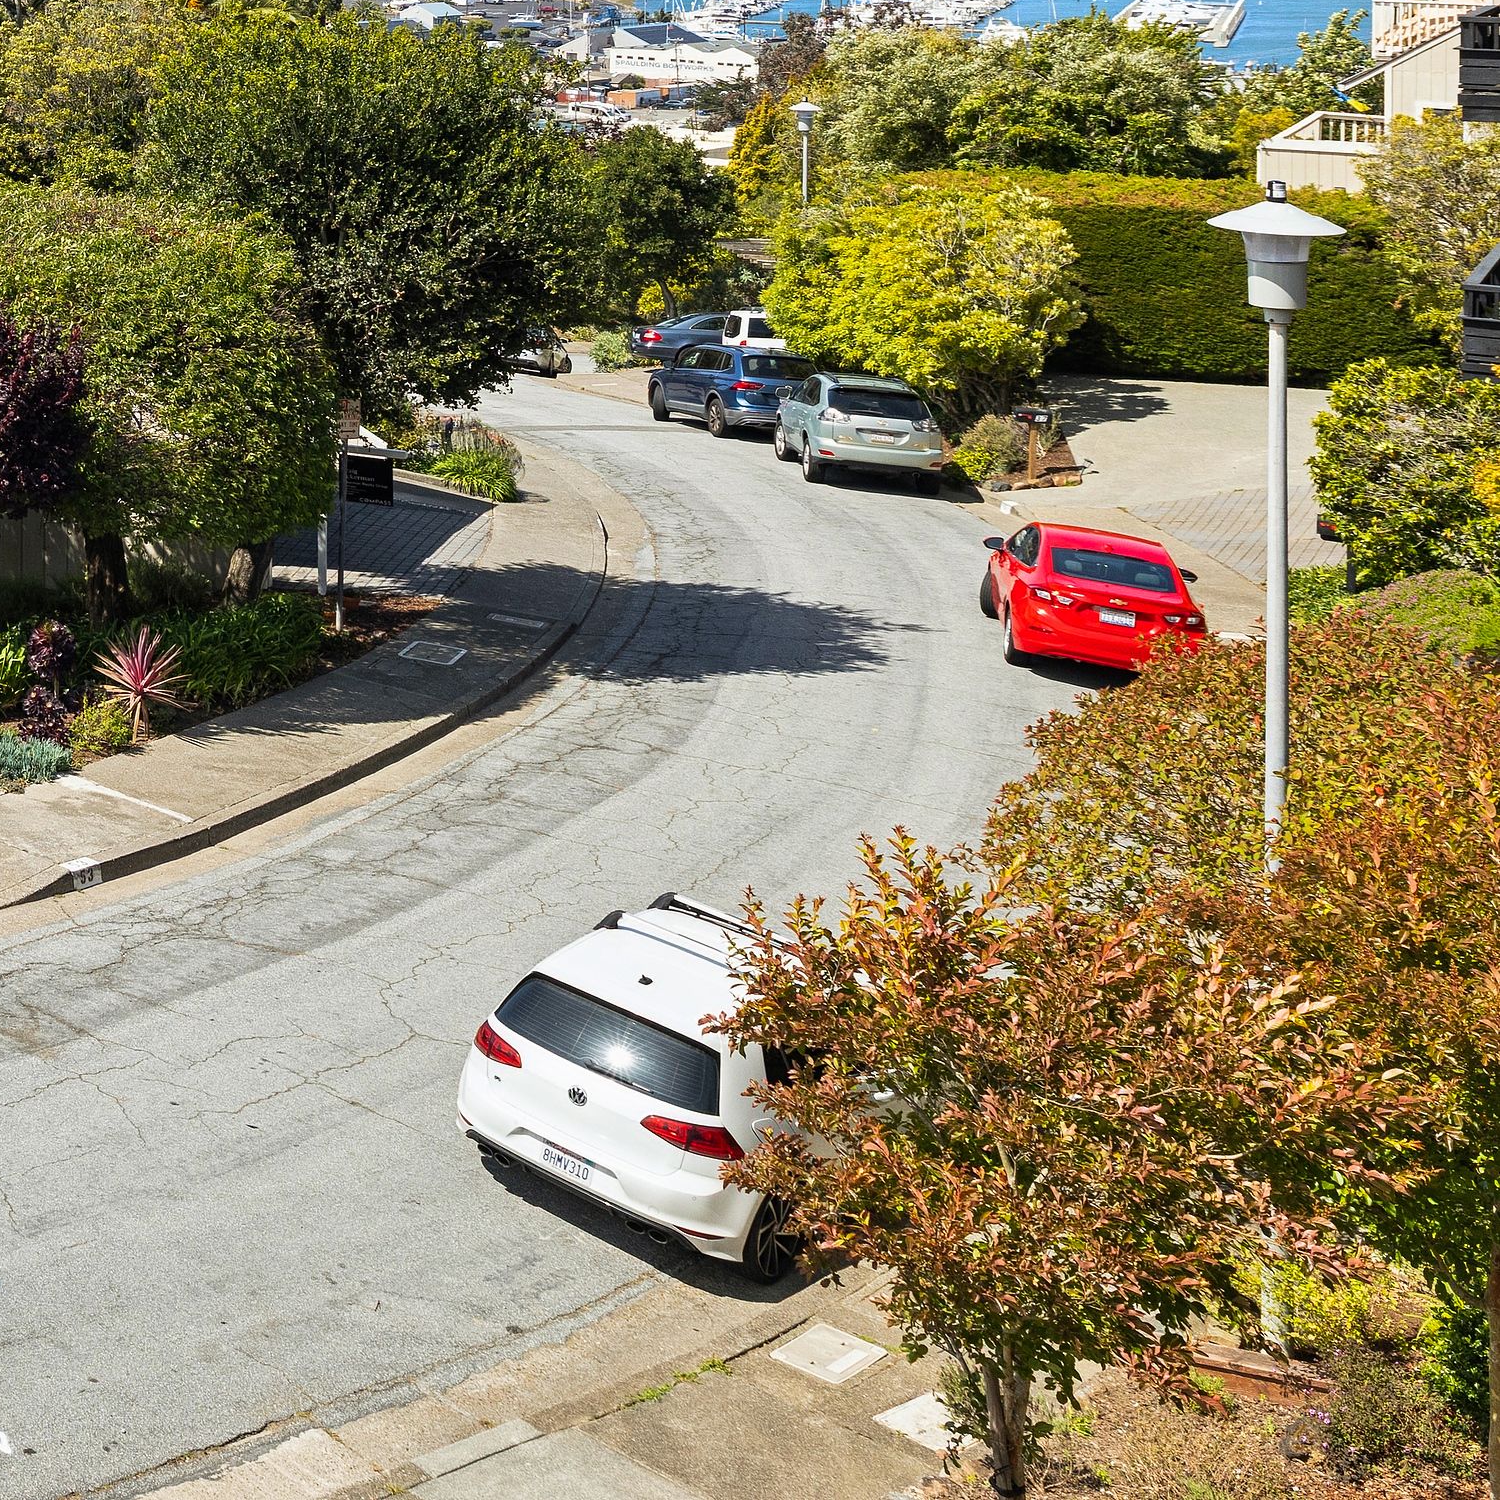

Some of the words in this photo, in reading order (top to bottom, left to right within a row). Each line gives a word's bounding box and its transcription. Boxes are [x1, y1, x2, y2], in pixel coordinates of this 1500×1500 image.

[615, 59, 661, 68] SPAULDING
[662, 62, 715, 72] BOATWORKS
[359, 497, 392, 506] COMPASS
[80, 867, 94, 884] 53
[542, 1148, 590, 1181] 8HMV310
